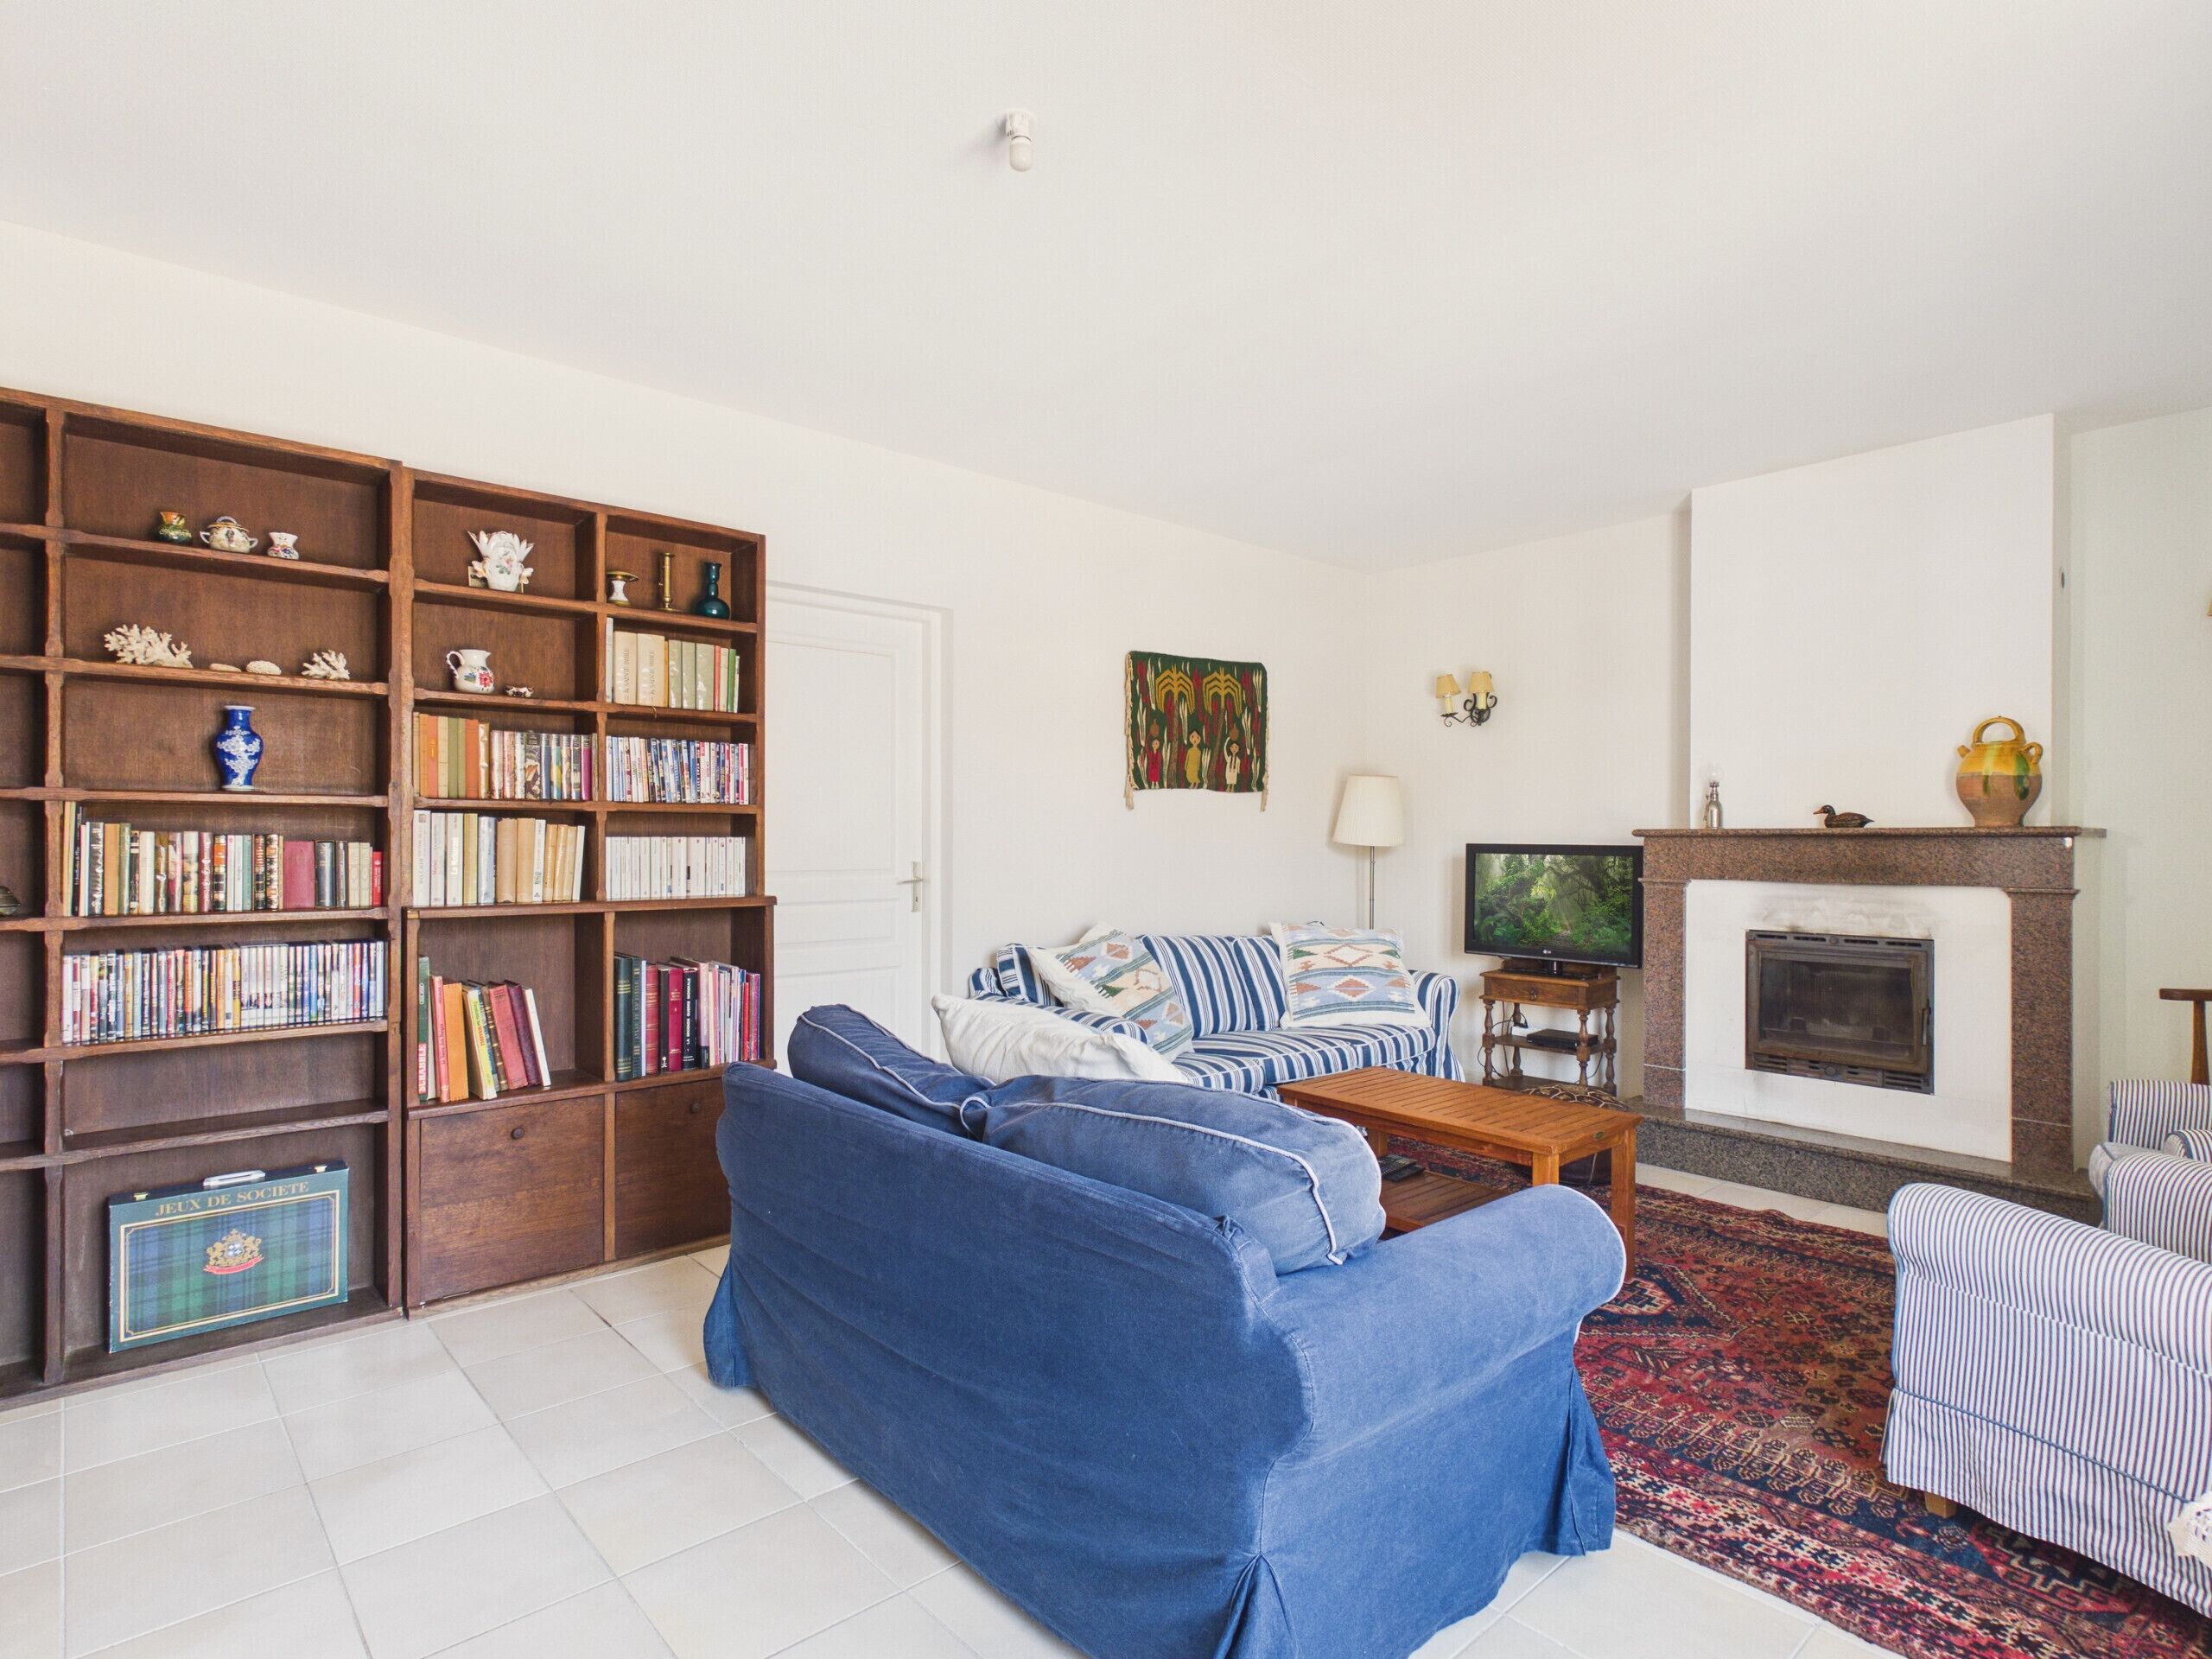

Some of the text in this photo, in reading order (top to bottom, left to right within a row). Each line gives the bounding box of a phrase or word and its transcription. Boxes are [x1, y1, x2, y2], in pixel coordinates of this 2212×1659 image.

[418, 1043, 427, 1094] SCRABBLE
[156, 1181, 309, 1217] JEUX DE SOCIETE
